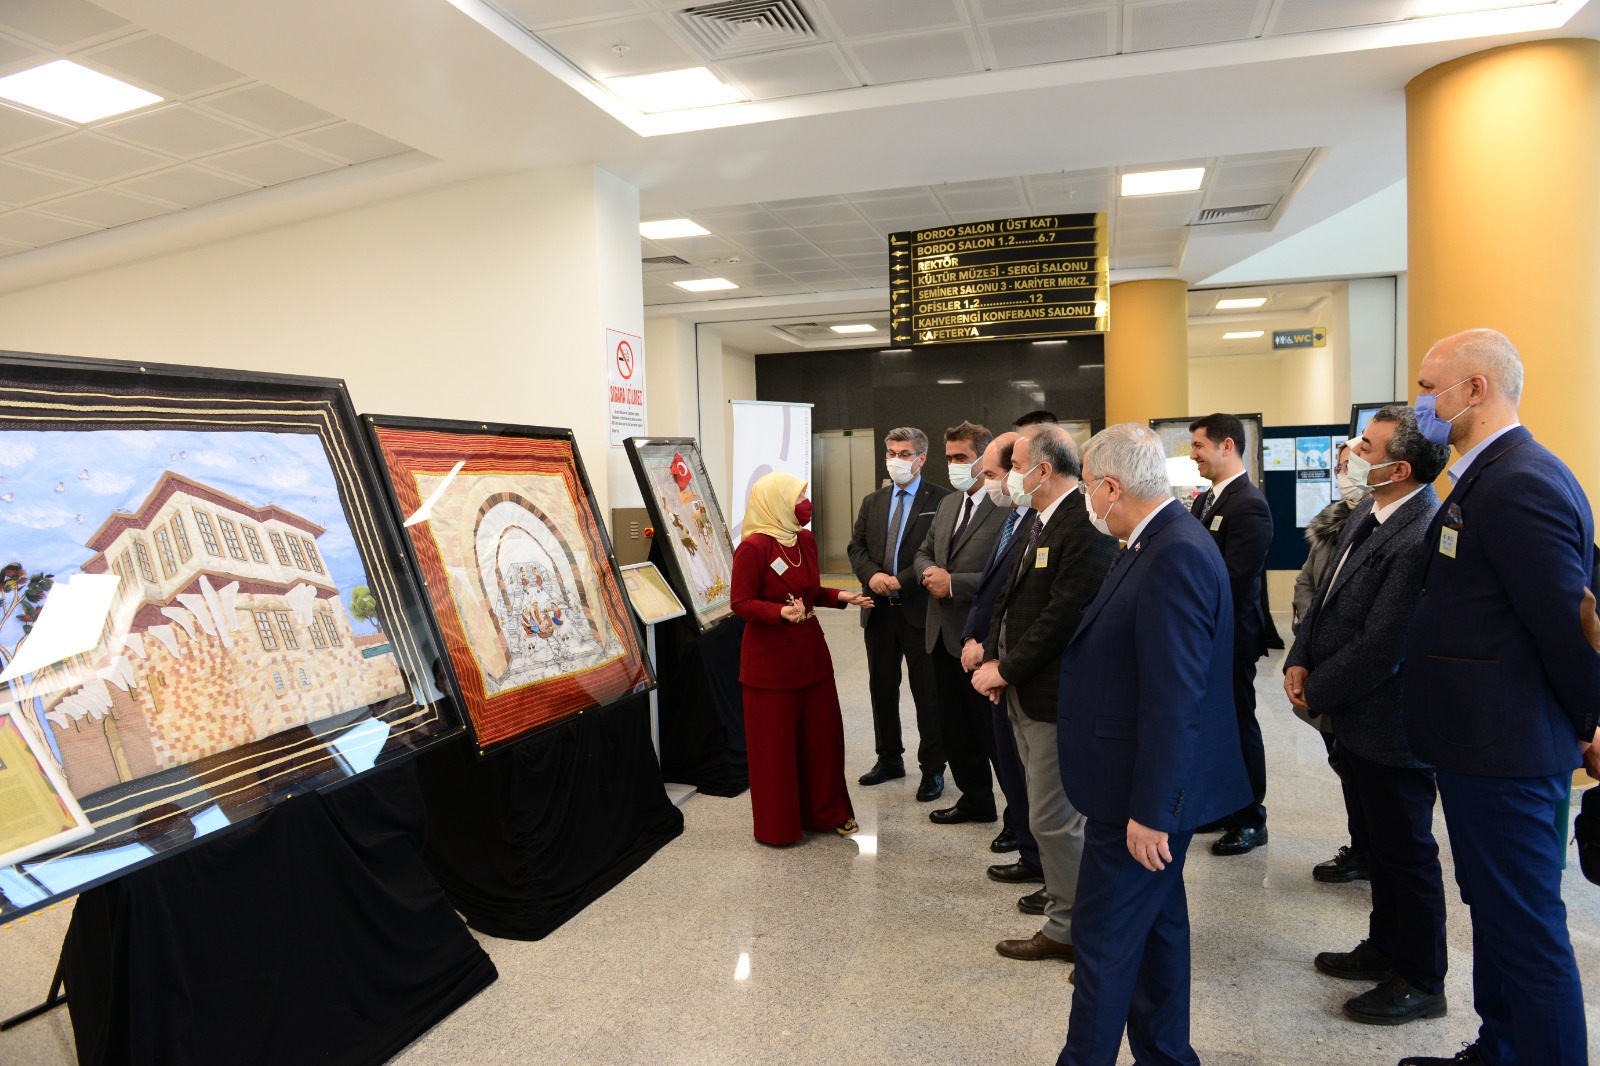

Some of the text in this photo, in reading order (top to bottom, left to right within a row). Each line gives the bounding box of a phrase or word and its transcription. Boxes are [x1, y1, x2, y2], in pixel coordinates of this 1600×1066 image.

[917, 227, 956, 242] BORDO
[957, 222, 995, 236] SALON
[1006, 218, 1028, 231] ÜST
[1030, 217, 1053, 229] KAT
[917, 242, 956, 256] BORDO
[958, 235, 995, 250] SALON
[917, 256, 958, 271] REKTÖR
[918, 271, 958, 286] KÜLTÜR
[958, 265, 999, 281] MÜZESİ
[1007, 261, 1040, 276] SERGİ
[1042, 261, 1089, 273] SALONU
[918, 284, 958, 300] SEMİNER
[960, 282, 999, 295] SALONU
[1000, 282, 1007, 291] 3
[1014, 275, 1056, 290] KARİYER
[1058, 276, 1090, 287] MRKZ.
[918, 298, 961, 314] OFİSLER
[918, 305, 1091, 328] KAHVERENGİ KONFERANS SALONU
[919, 326, 979, 341] KAFETERYA
[1294, 334, 1311, 343] WC
